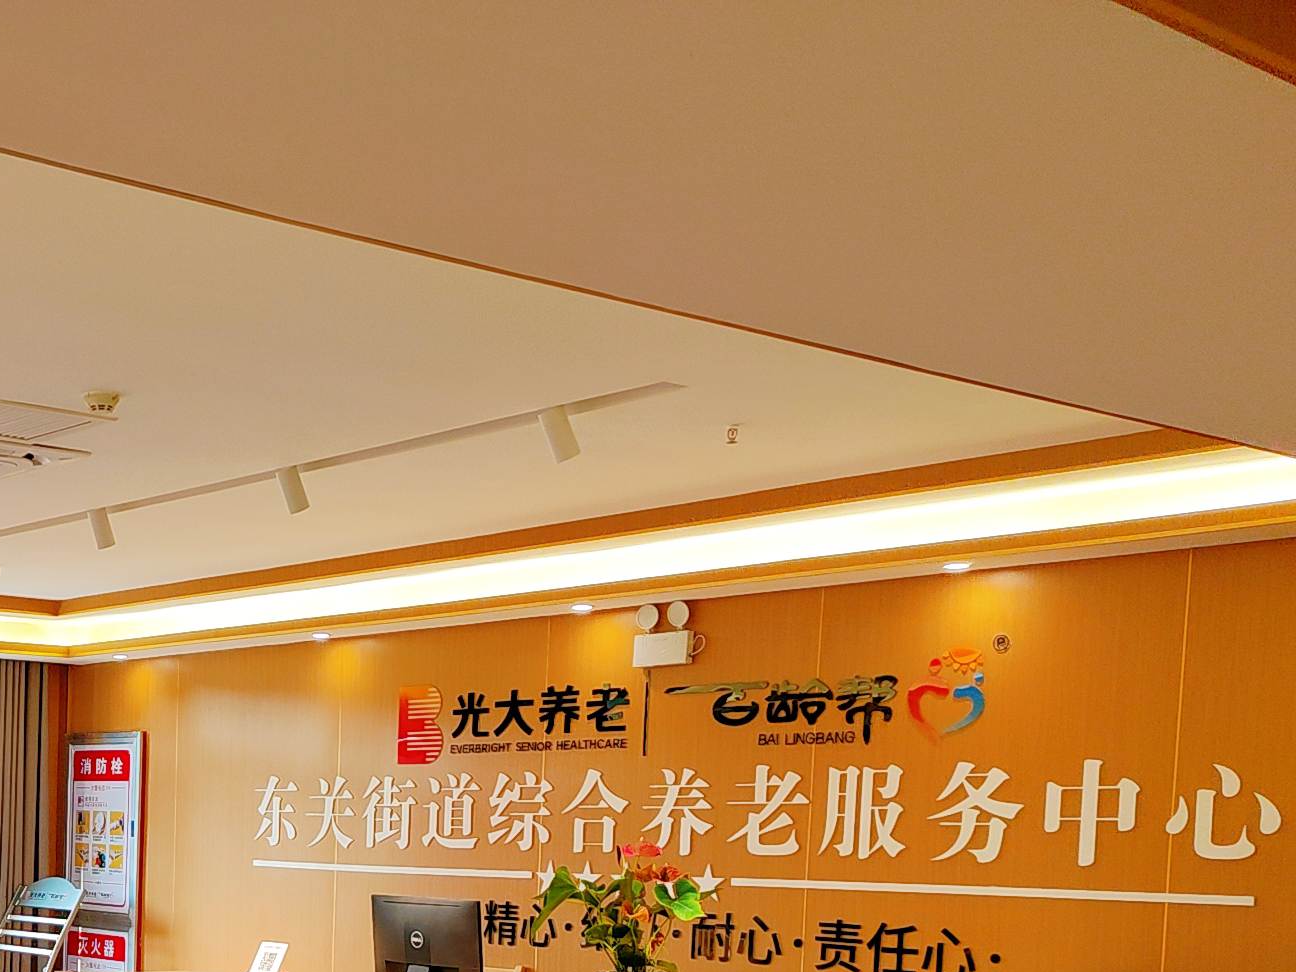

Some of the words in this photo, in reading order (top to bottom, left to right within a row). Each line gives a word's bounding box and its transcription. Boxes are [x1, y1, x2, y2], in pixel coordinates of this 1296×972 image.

[451, 684, 630, 738] 光大养老
[665, 675, 898, 745] 百龄帮
[450, 743, 512, 754] EVERBRIGHT
[515, 741, 552, 752] SENIOR
[556, 739, 628, 750] HEALTHCARE
[758, 732, 780, 745] BAI
[784, 731, 856, 745] LINGBANG
[80, 757, 124, 775] 消防栓
[253, 761, 1284, 867] 东关街道综合养老服务中心
[78, 936, 114, 958] 灭火器
